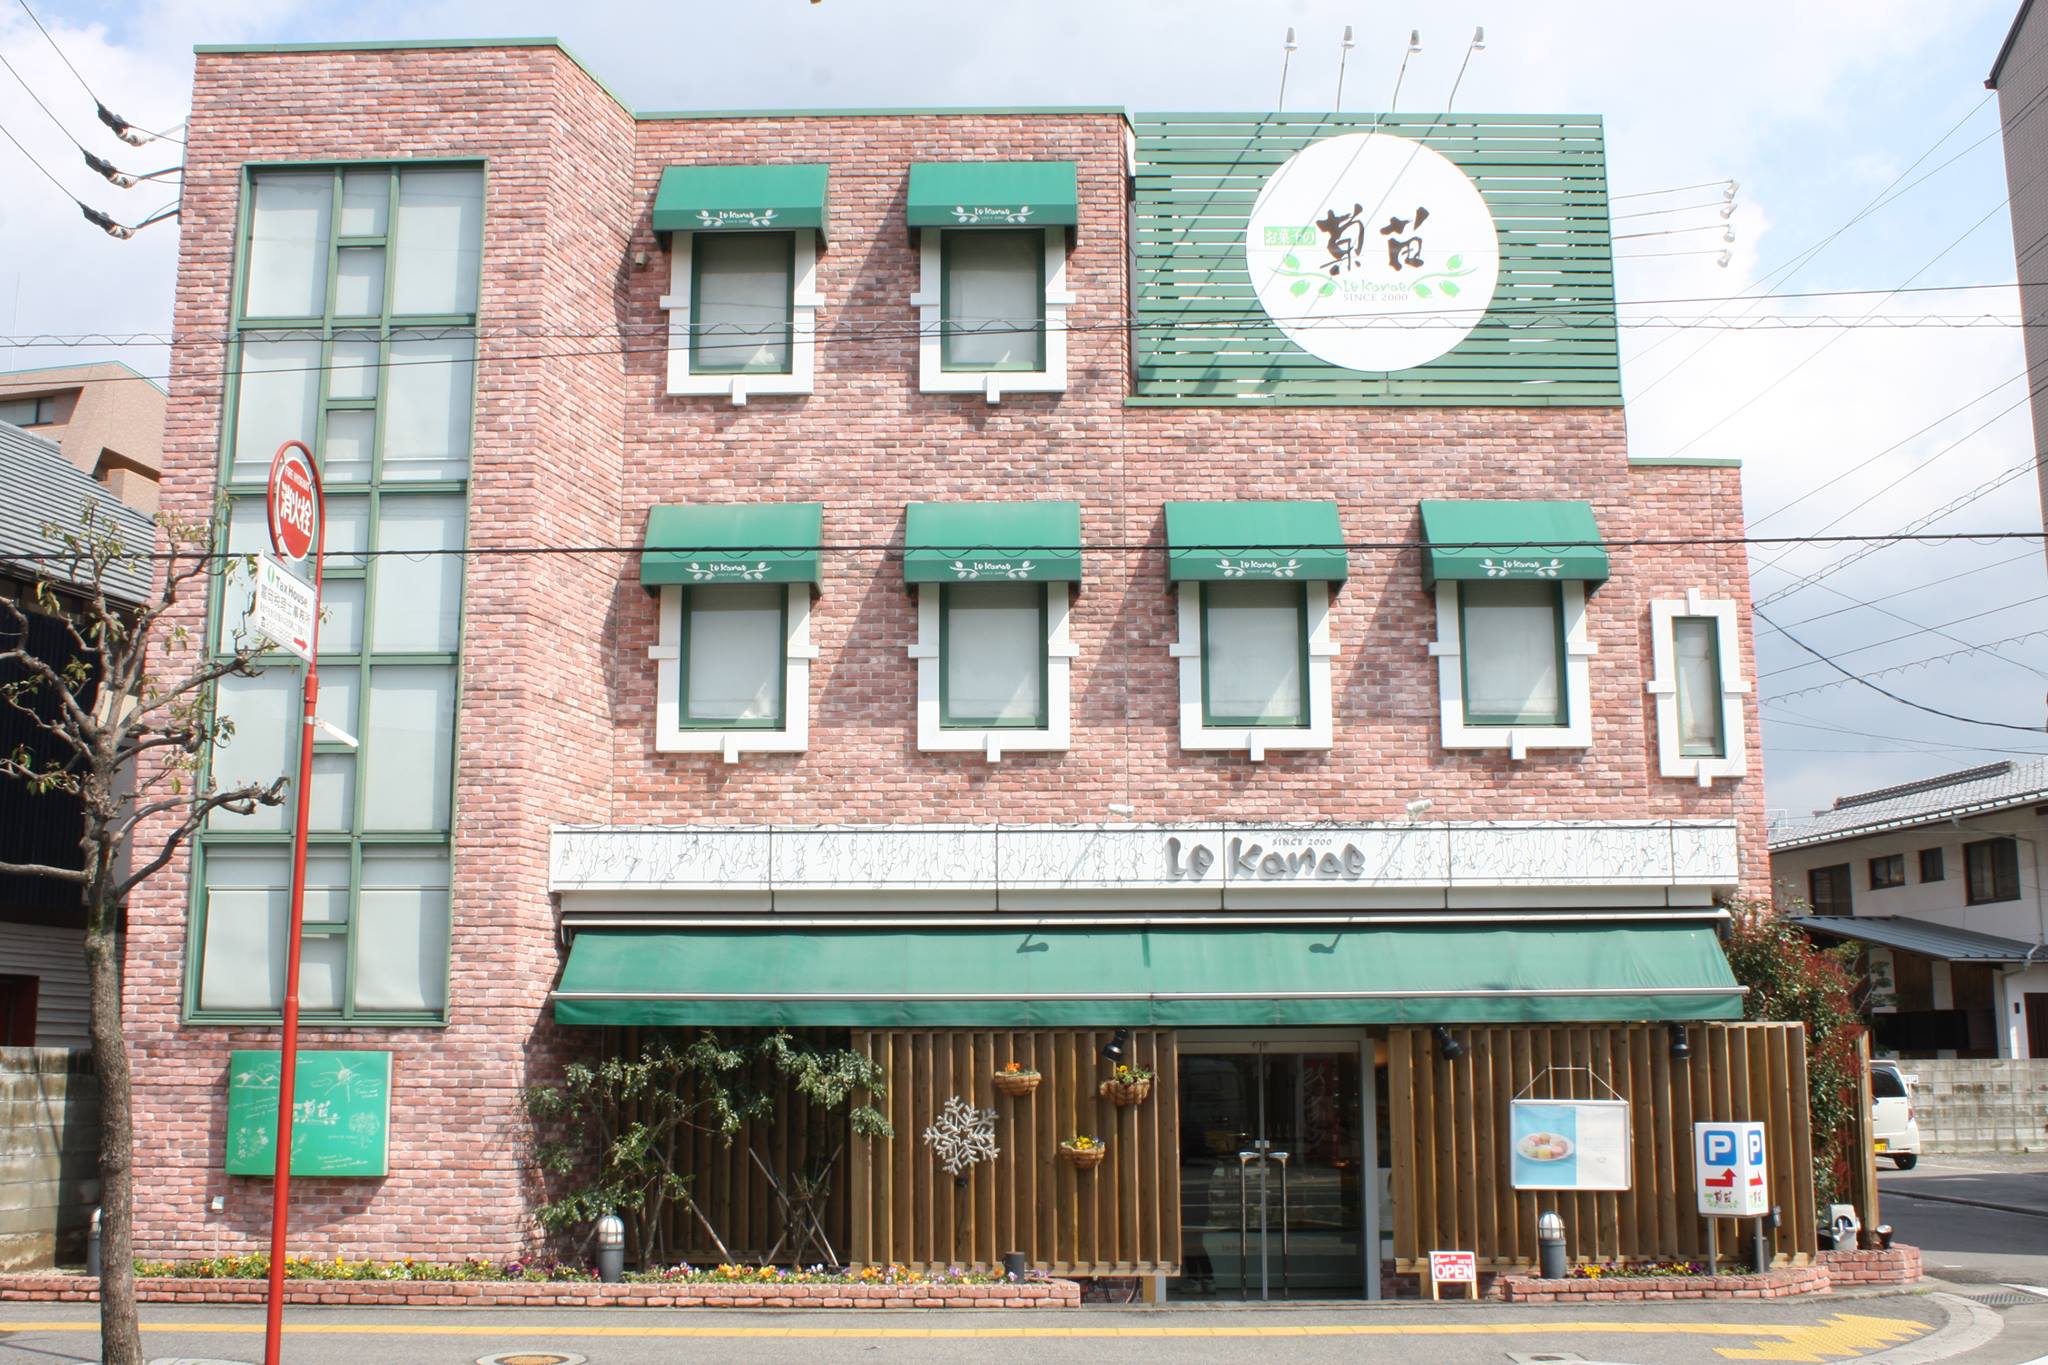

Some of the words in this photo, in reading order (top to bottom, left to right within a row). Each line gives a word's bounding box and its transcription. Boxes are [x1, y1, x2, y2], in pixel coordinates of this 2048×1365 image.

[1316, 203, 1430, 276] 菓苗
[1343, 293, 1377, 302] SINCE
[1381, 293, 1409, 302] 2000
[280, 480, 312, 537] 消火栓
[275, 576, 288, 595] Tax
[288, 585, 308, 608] House
[1272, 838, 1303, 846] SINCE
[1308, 838, 1332, 846] 2000
[1165, 837, 1214, 881] Le
[1227, 836, 1365, 881] Kanae
[1708, 1135, 1732, 1161] P
[1750, 1134, 1761, 1161] P
[1435, 1264, 1472, 1279] OPEN
